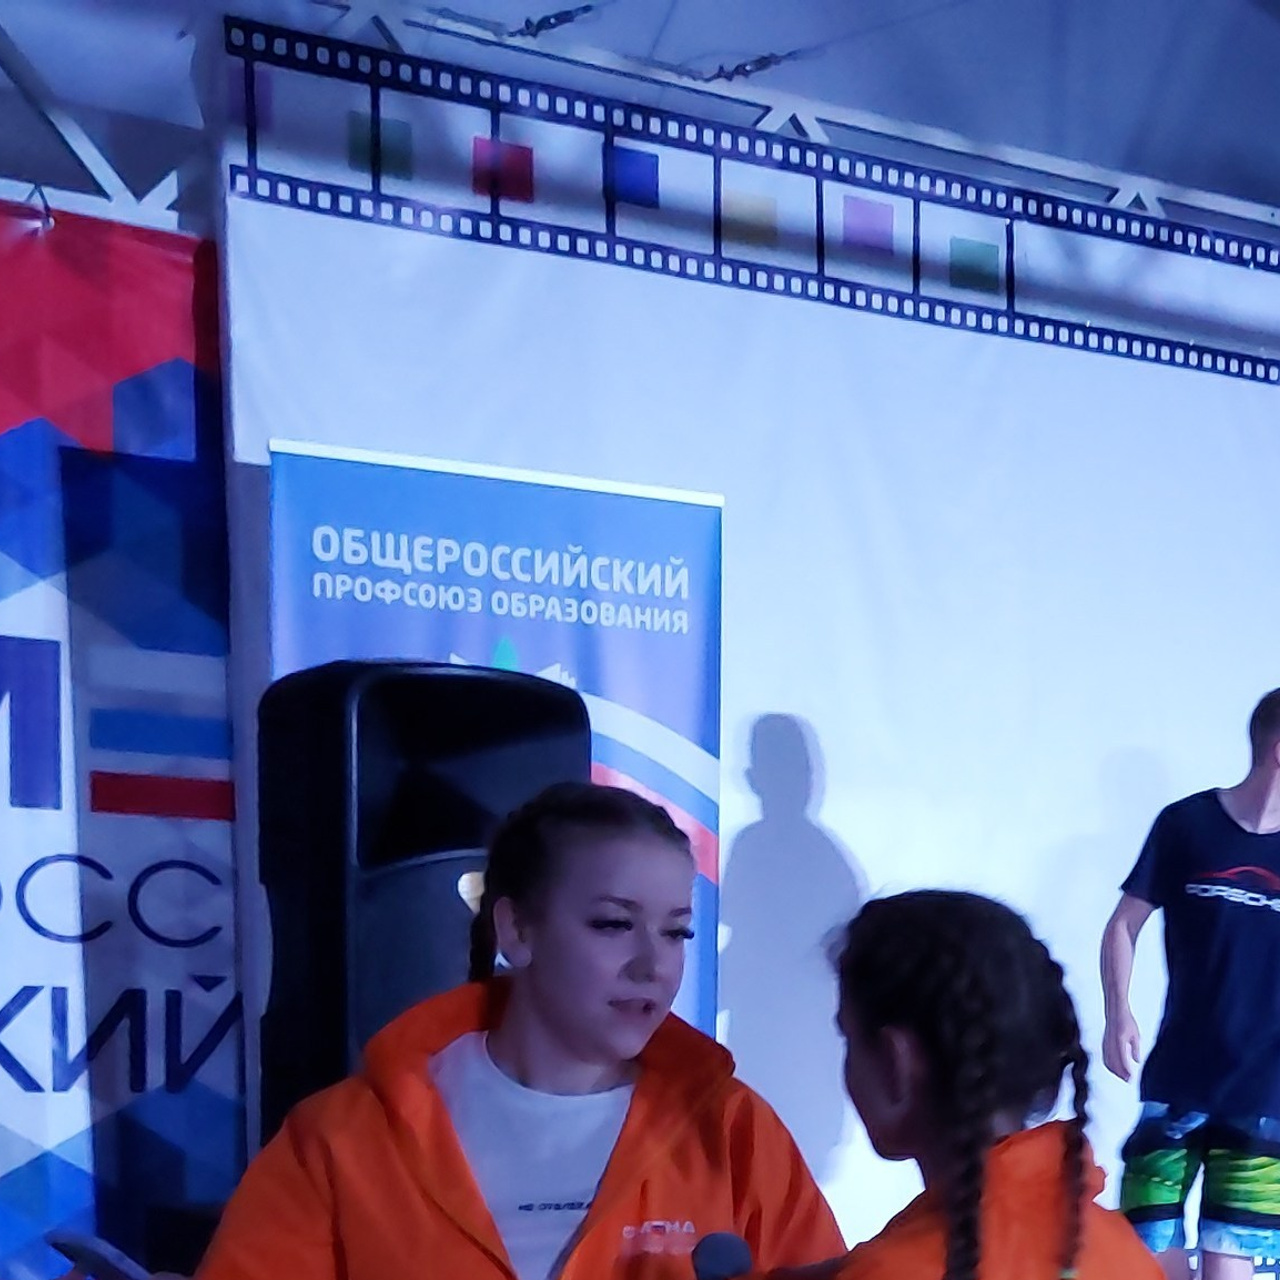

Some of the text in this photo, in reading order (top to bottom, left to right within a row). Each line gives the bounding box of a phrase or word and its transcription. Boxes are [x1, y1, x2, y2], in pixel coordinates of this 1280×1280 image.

[312, 525, 689, 599] ОБЩЕРОССИЙСКИЙ
[313, 572, 689, 634] ПРОФСОЮЗ ОБРАЗОВАНИЯ
[0, 853, 222, 949] СС
